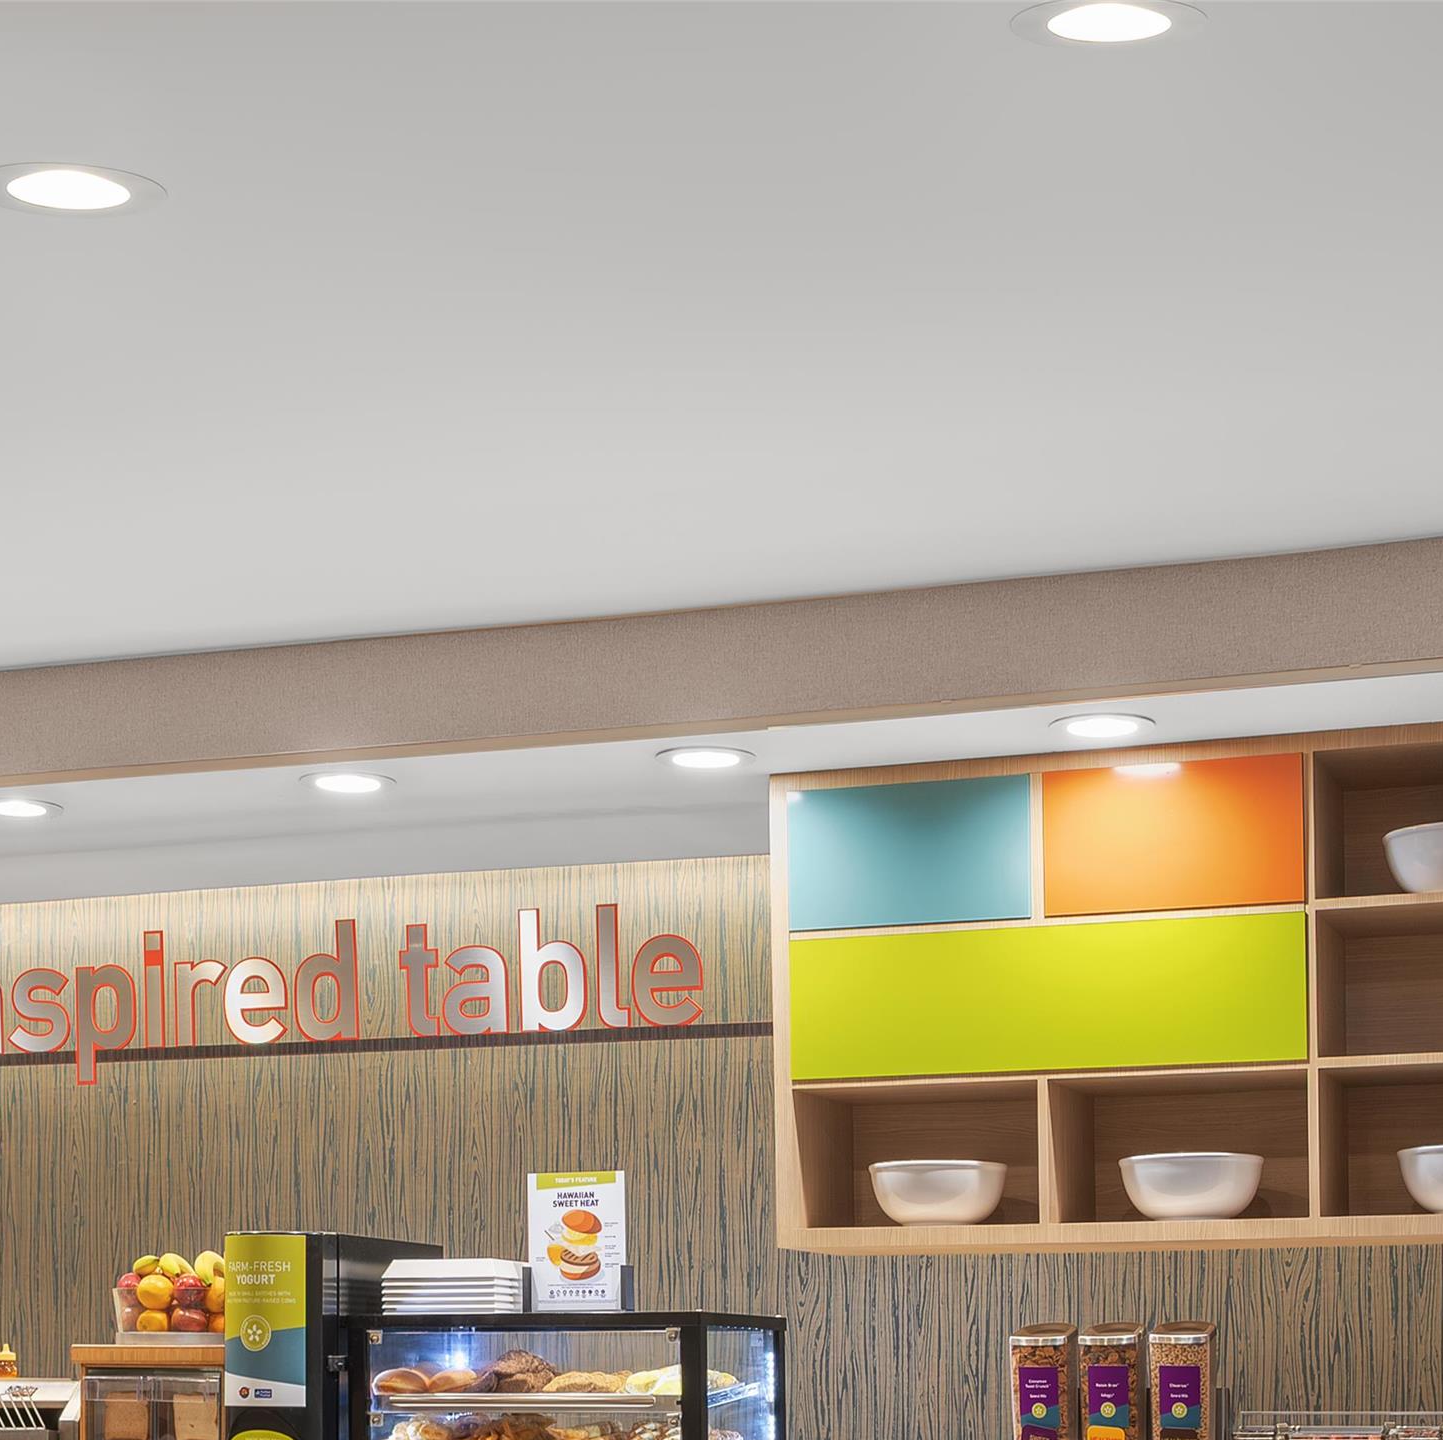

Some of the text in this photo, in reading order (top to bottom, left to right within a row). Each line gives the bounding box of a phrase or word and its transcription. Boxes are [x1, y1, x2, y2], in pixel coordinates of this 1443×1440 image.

[399, 903, 704, 1038] table
[557, 1191, 595, 1199] HAWAIIAN
[552, 1199, 599, 1208] SWEET HEAT
[228, 1260, 291, 1272] FARM-FRESH
[236, 1274, 276, 1285] YOGURT
